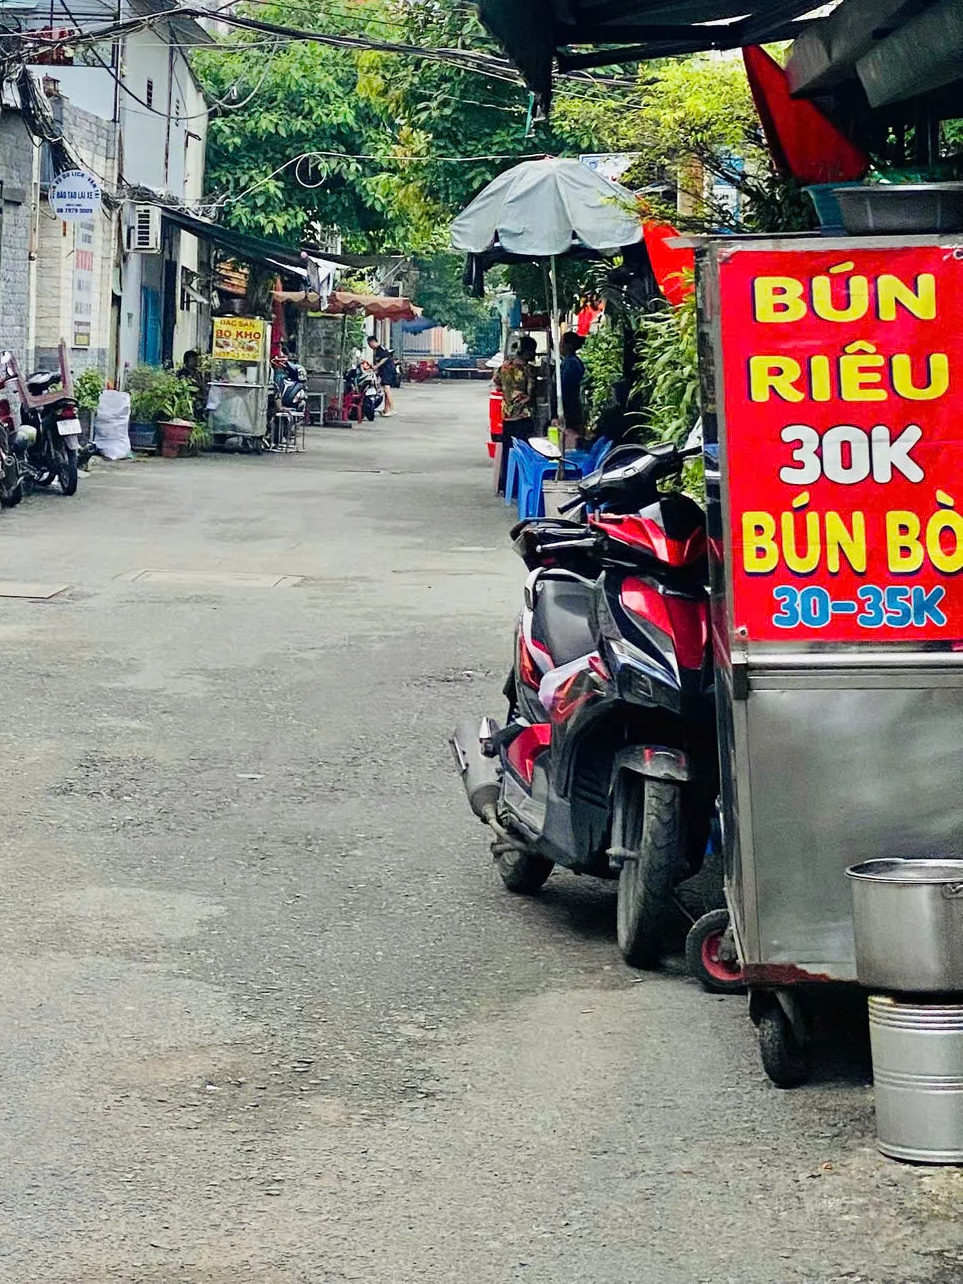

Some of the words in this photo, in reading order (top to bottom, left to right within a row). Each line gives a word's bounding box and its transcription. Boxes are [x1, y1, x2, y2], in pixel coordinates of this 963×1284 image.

[752, 261, 937, 323] BÚN
[236, 330, 261, 340] KHO
[747, 339, 950, 403] RIÊU
[779, 423, 926, 486] 30K
[740, 490, 868, 576] BÚN
[884, 489, 963, 576] BÒ
[771, 583, 948, 628] 30-35K
